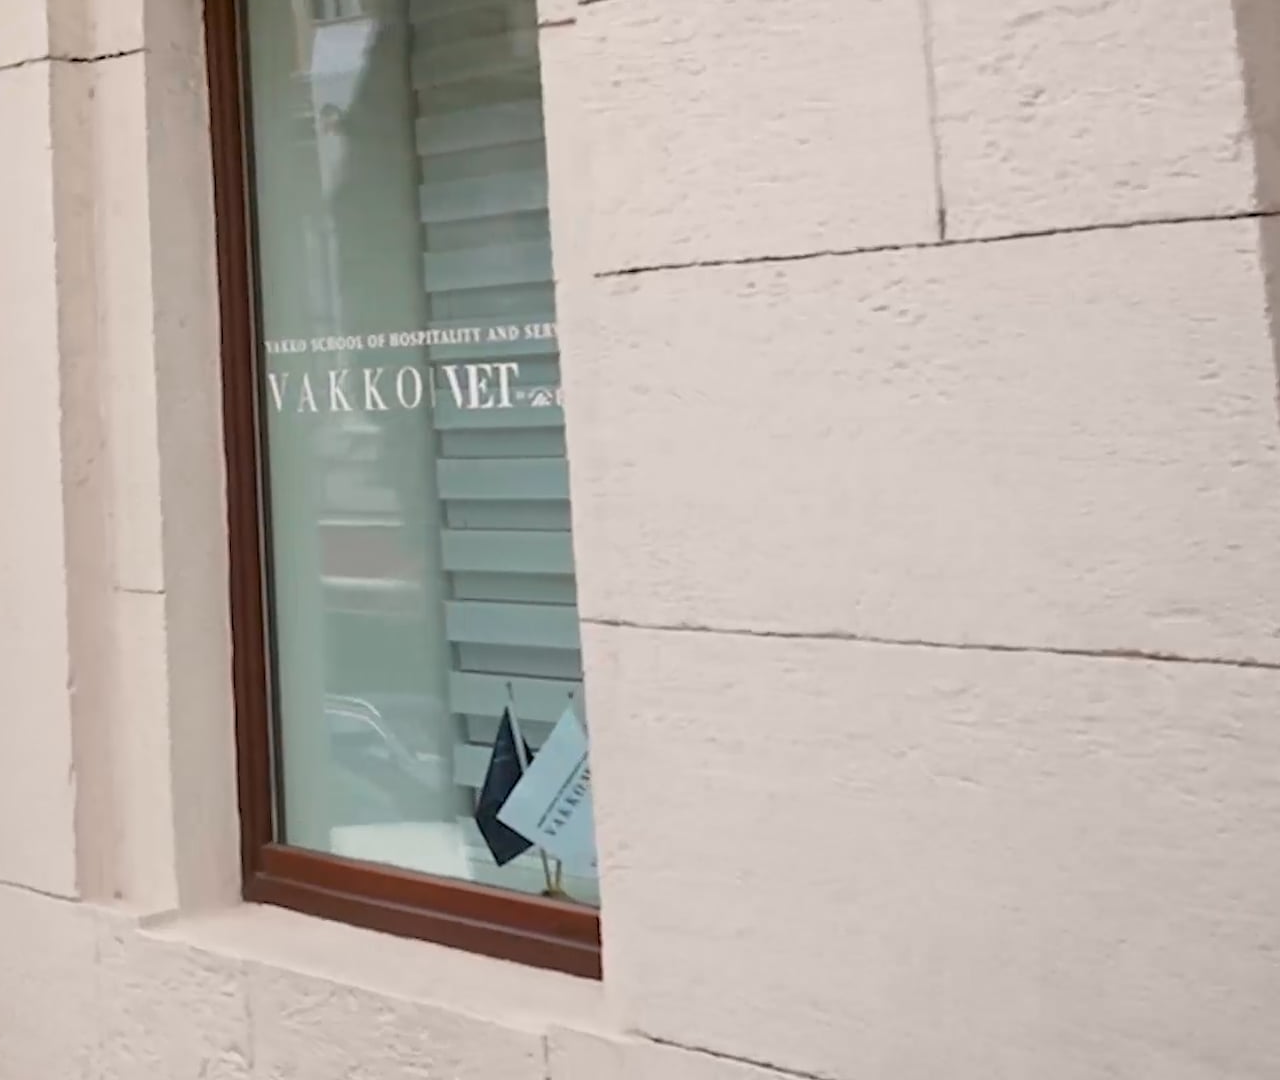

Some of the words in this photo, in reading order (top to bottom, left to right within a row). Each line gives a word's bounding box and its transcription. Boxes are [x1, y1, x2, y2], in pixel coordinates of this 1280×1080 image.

[311, 335, 363, 352] SCHOOL
[367, 334, 386, 349] OF
[389, 328, 481, 348] HOSPITALITY
[486, 325, 520, 341] AND
[268, 366, 423, 413] VAKKO
